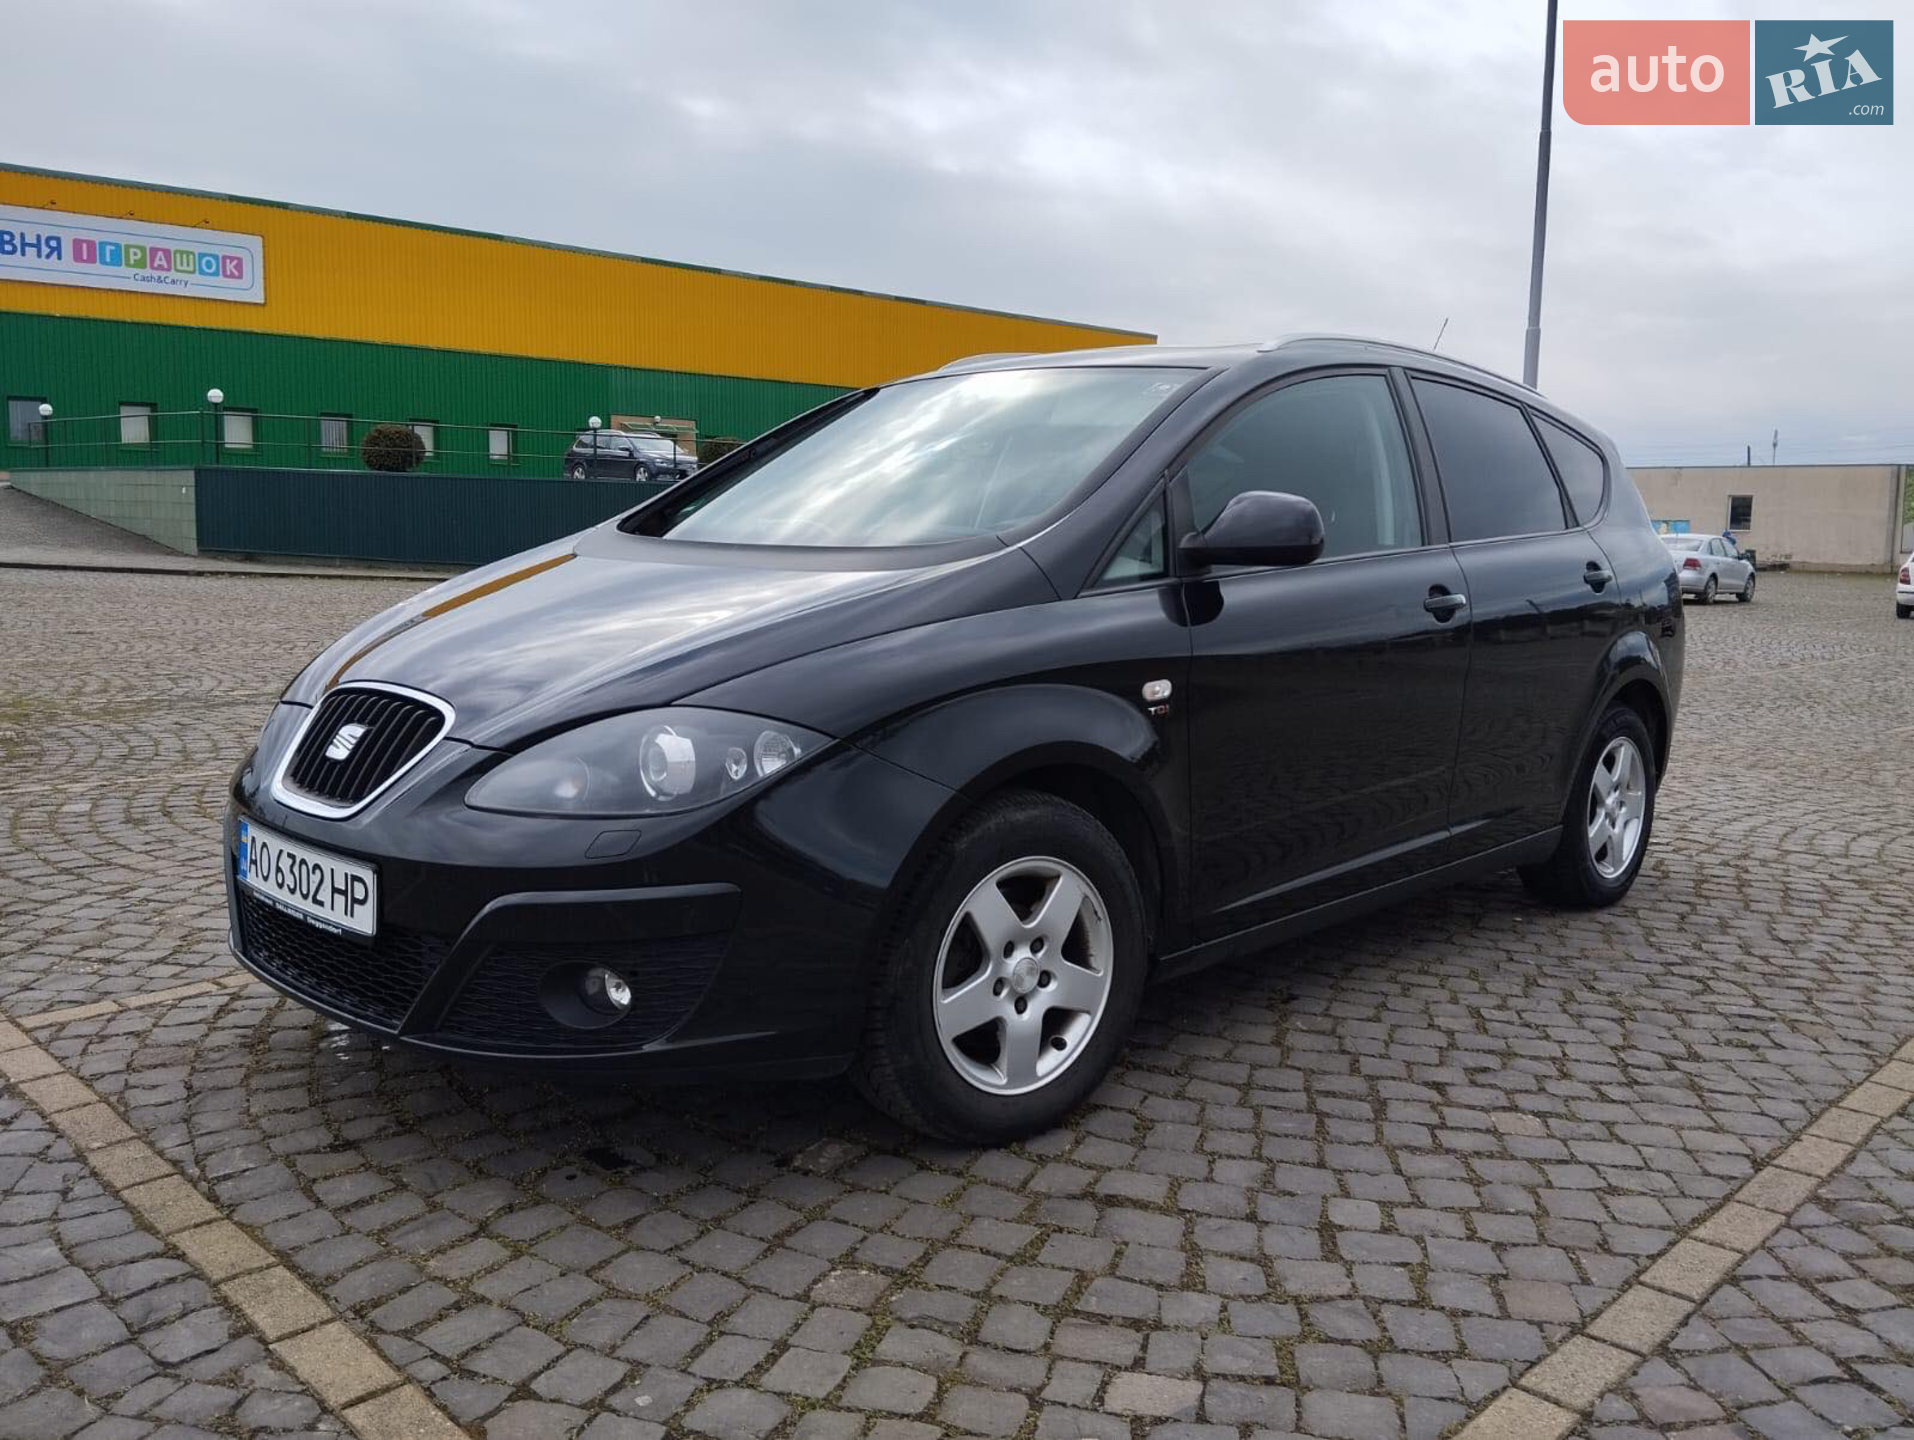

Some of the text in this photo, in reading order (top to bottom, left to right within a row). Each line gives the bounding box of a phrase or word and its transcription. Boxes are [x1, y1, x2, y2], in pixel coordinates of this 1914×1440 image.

[0, 230, 240, 277] ВНЯ ІГРАШОК
[133, 272, 189, 288] Cash&Carry
[249, 835, 271, 882] AO
[275, 849, 325, 909] 6302
[330, 867, 369, 918] HP
